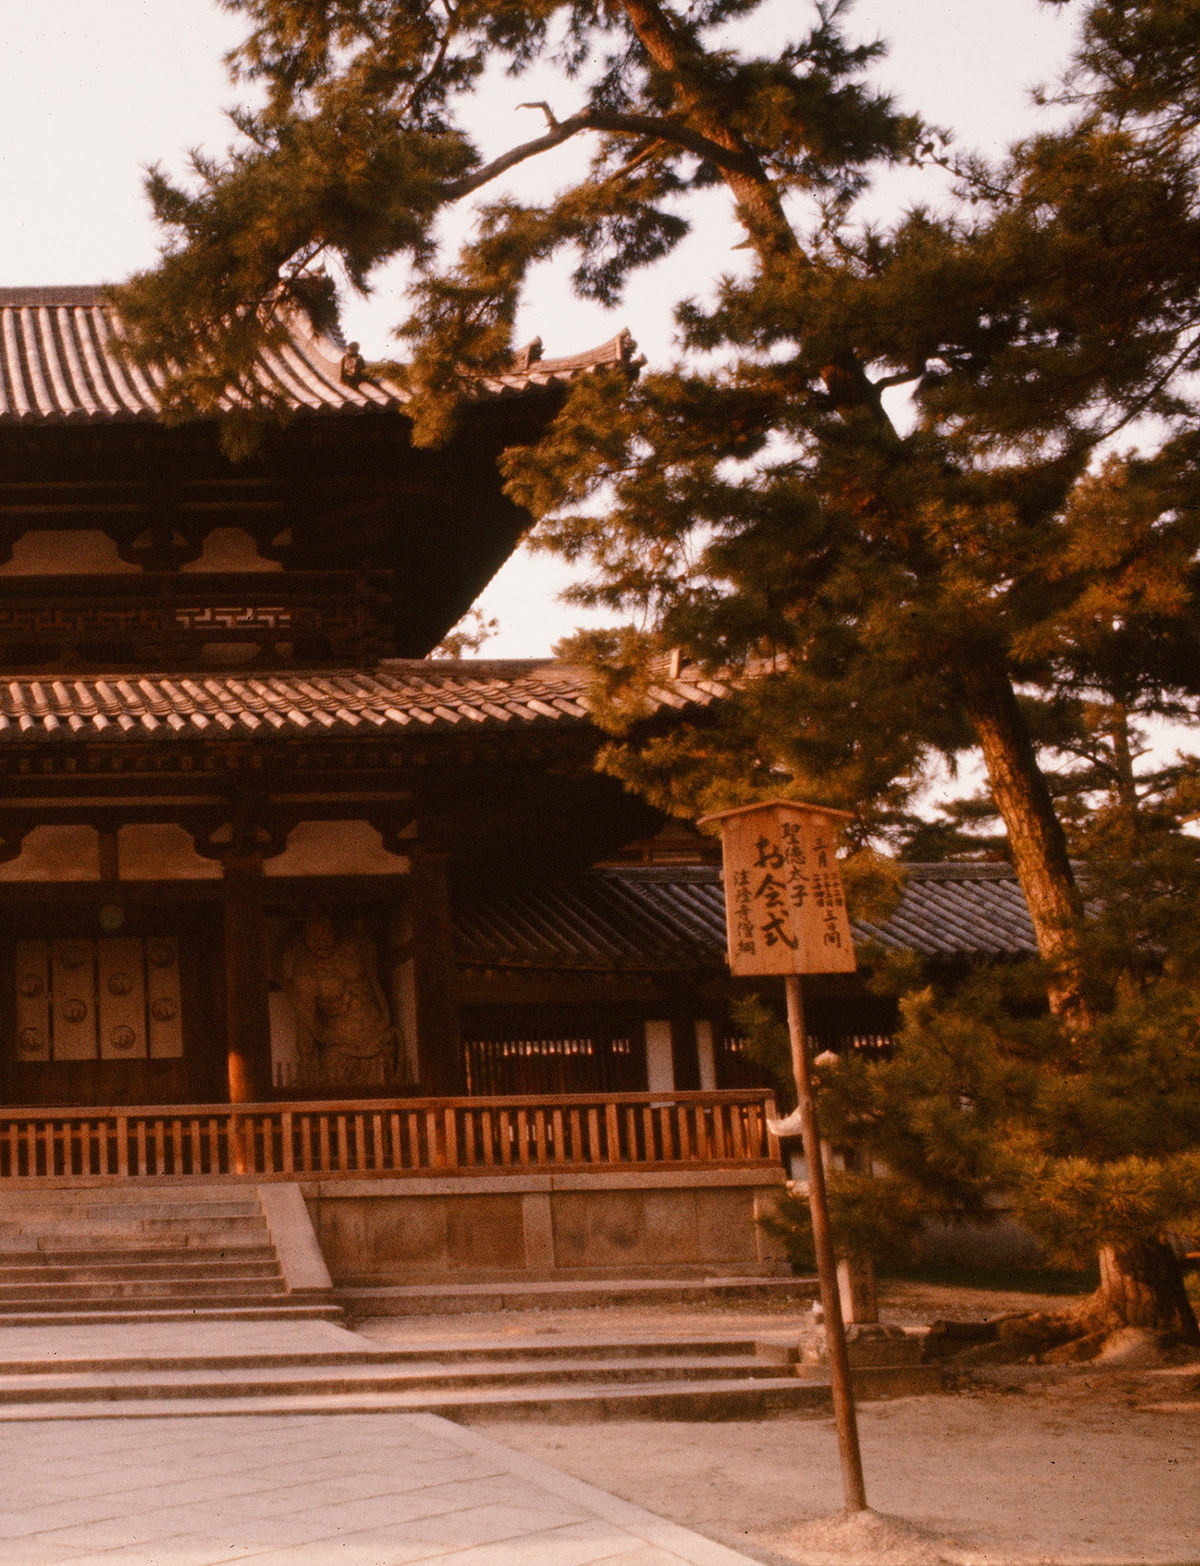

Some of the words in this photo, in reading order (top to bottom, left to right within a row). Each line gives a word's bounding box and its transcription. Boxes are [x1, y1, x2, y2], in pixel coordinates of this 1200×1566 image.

[753, 833, 799, 951] お会式
[780, 822, 810, 908] 聖徳太子
